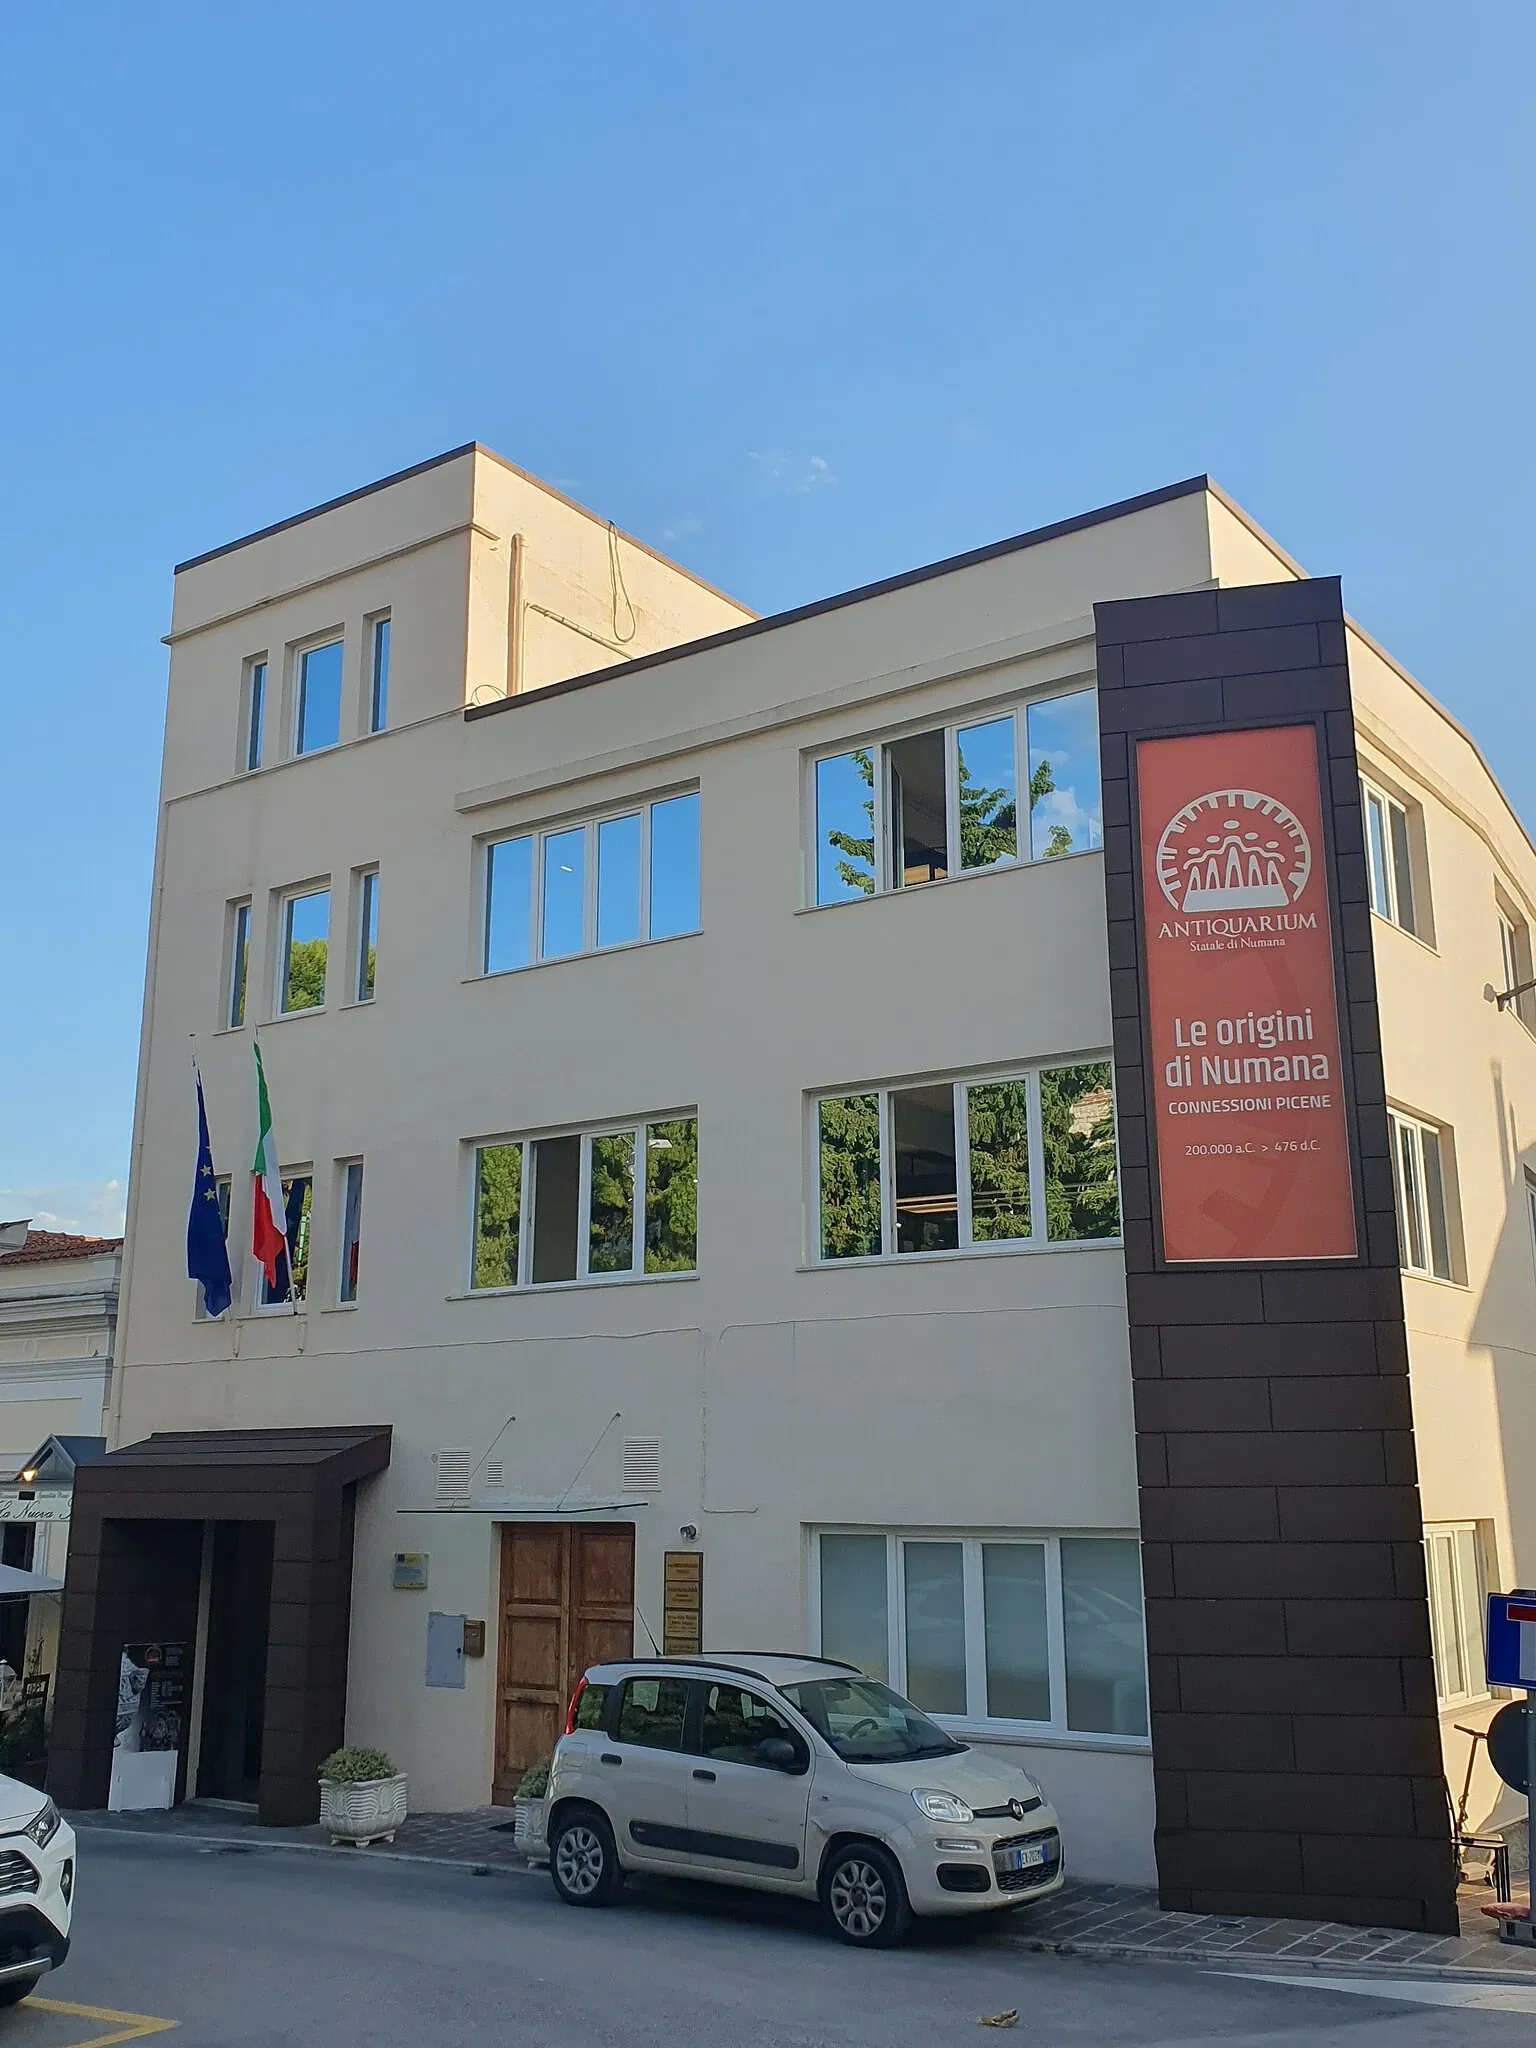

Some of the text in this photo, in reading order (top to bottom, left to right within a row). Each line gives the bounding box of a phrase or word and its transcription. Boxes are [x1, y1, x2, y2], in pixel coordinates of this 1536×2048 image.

[1158, 912, 1318, 939] ANTIQUARIUM
[1189, 937, 1286, 952] Statale di Numana
[1174, 1007, 1314, 1049] Le origini
[1165, 1053, 1330, 1088] di Numana
[1168, 1094, 1332, 1115] CONNESSIONI PICENE
[1185, 1143, 1233, 1156] 200.000
[1235, 1142, 1255, 1154] a.C.
[1274, 1141, 1297, 1152] 476
[1300, 1139, 1321, 1151] d.C.
